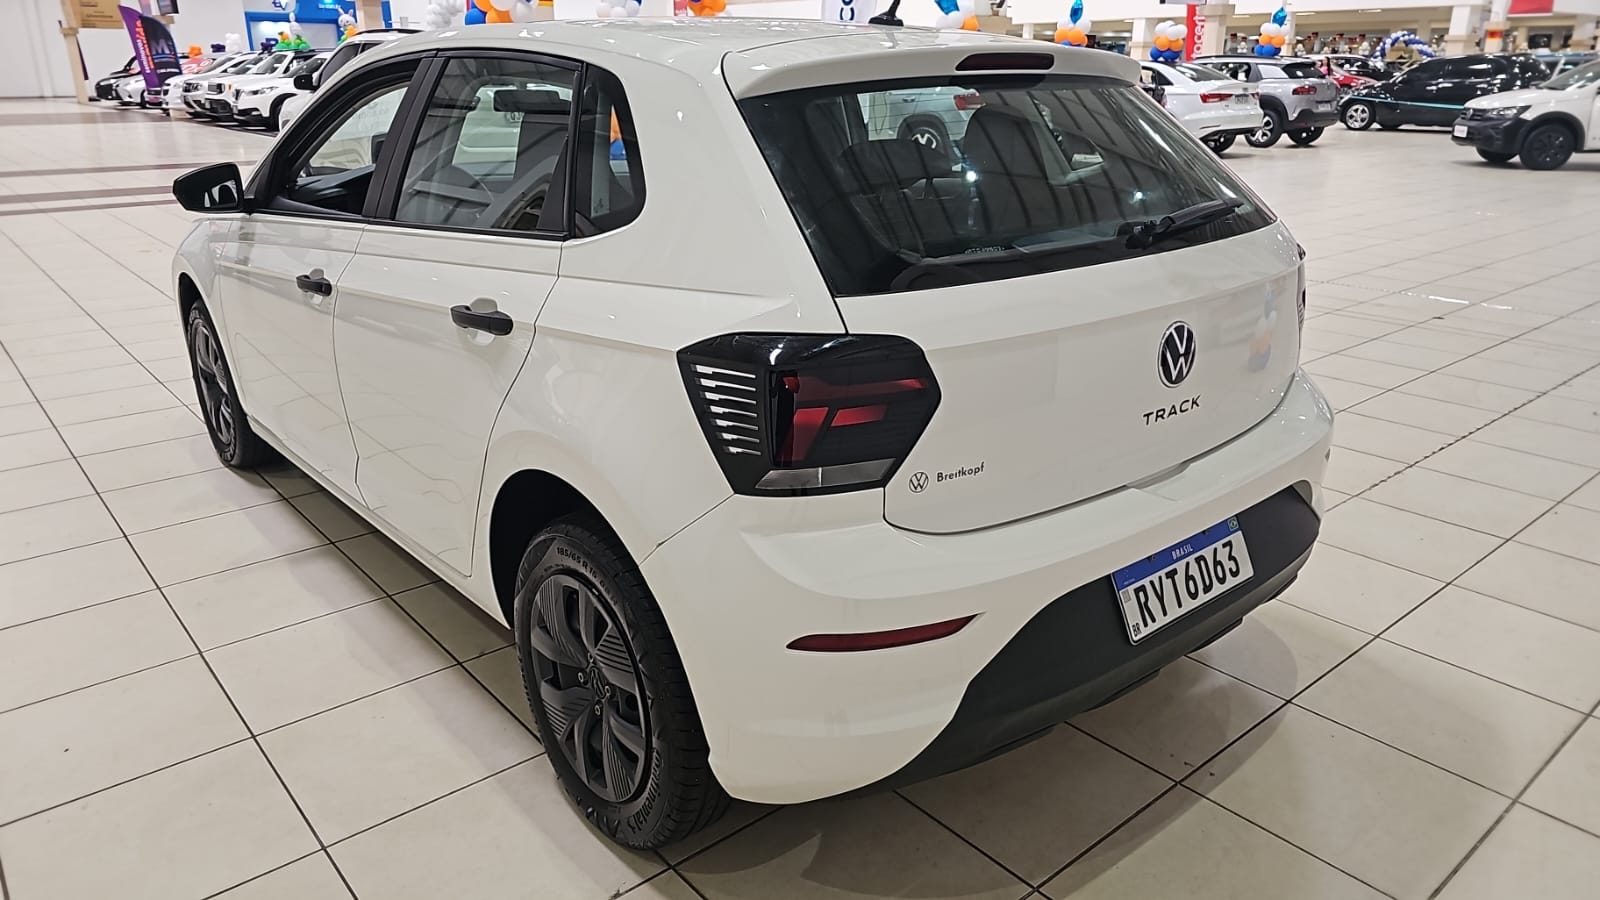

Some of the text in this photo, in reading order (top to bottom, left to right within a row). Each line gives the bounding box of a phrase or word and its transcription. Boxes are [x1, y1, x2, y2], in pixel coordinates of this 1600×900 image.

[1143, 395, 1201, 425] TRACK
[936, 461, 984, 482] Breitkopf
[1172, 544, 1193, 560] BRASIL
[1133, 540, 1240, 628] RYT6D63
[1132, 622, 1142, 637] BR
